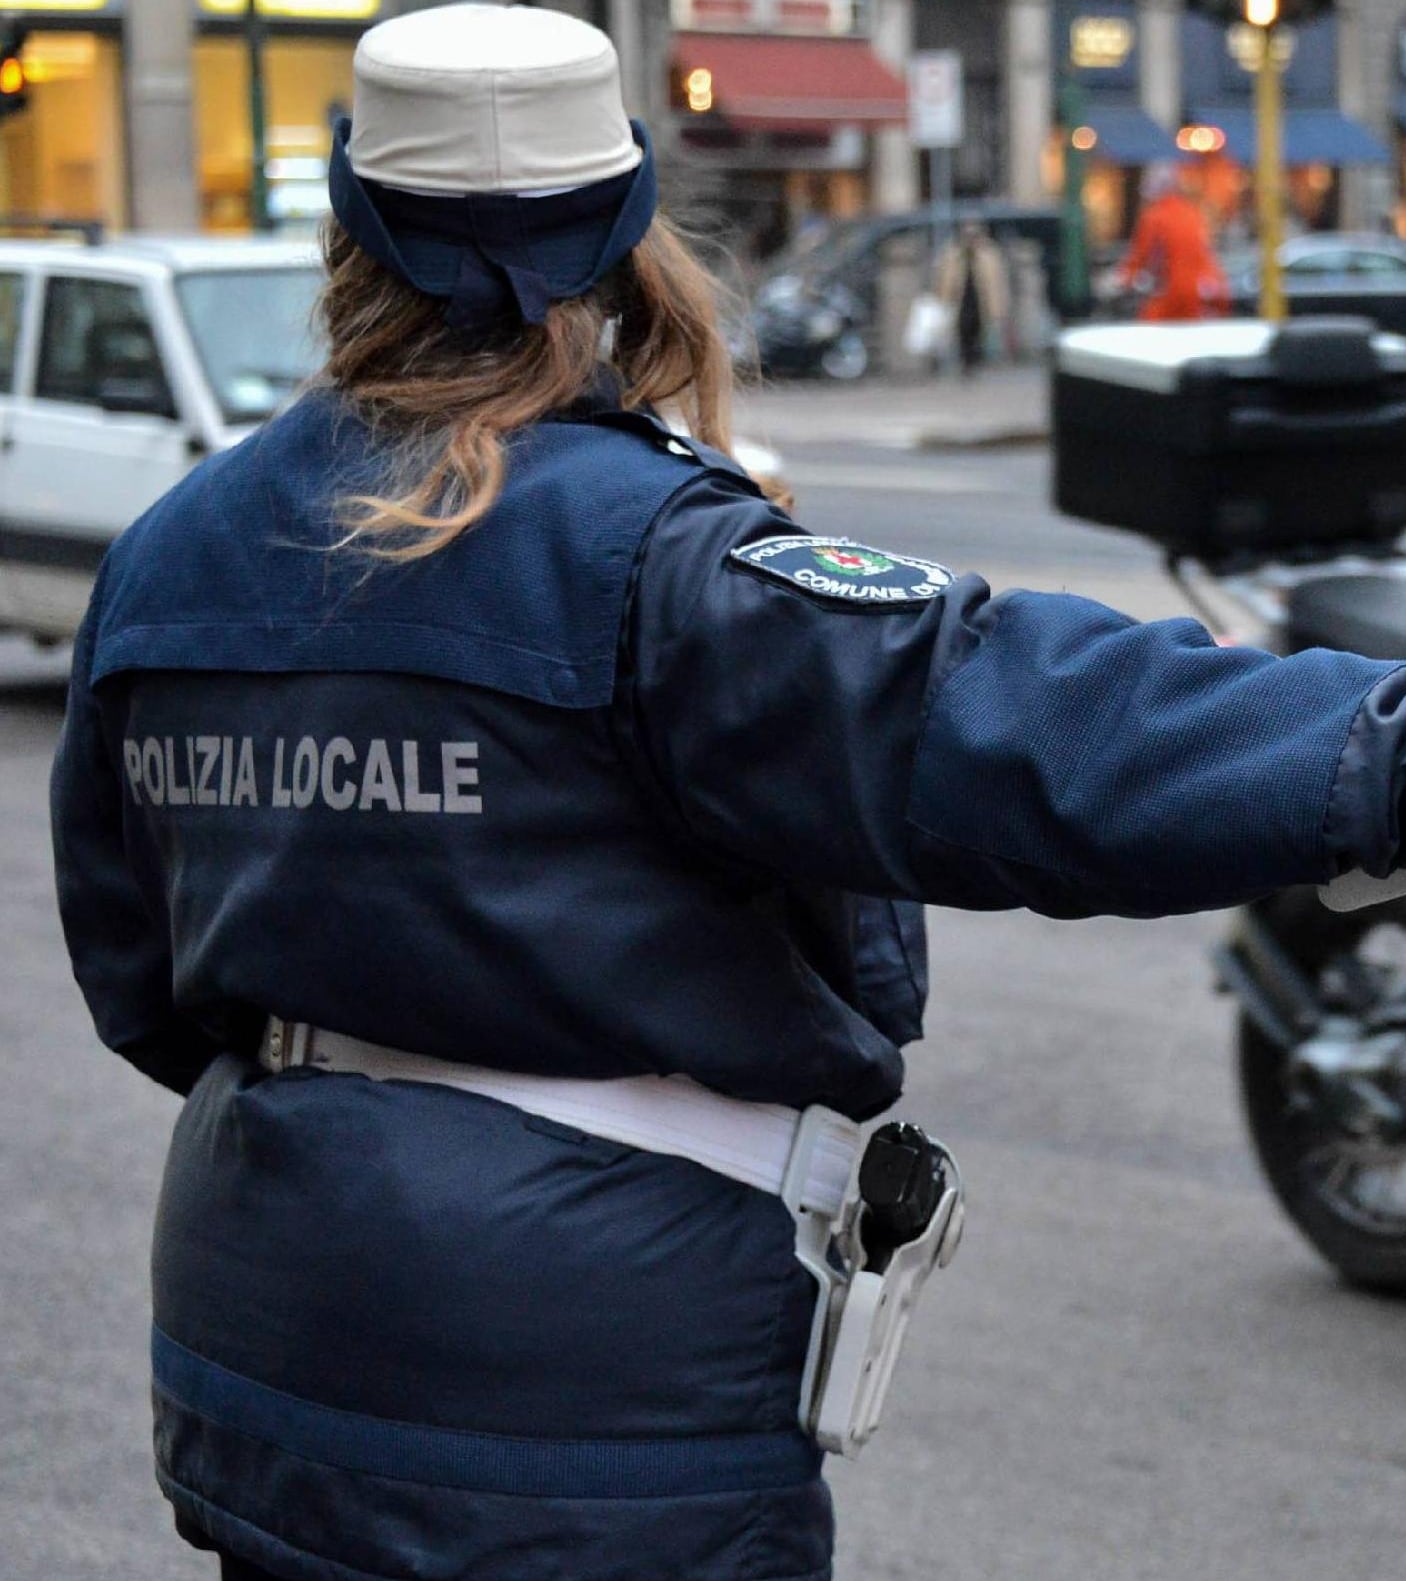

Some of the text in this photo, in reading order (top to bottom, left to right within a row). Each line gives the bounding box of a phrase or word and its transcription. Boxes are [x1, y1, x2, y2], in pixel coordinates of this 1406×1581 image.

[793, 569, 908, 598] COMUNE
[122, 736, 483, 814] POLIZIA LOCALE
